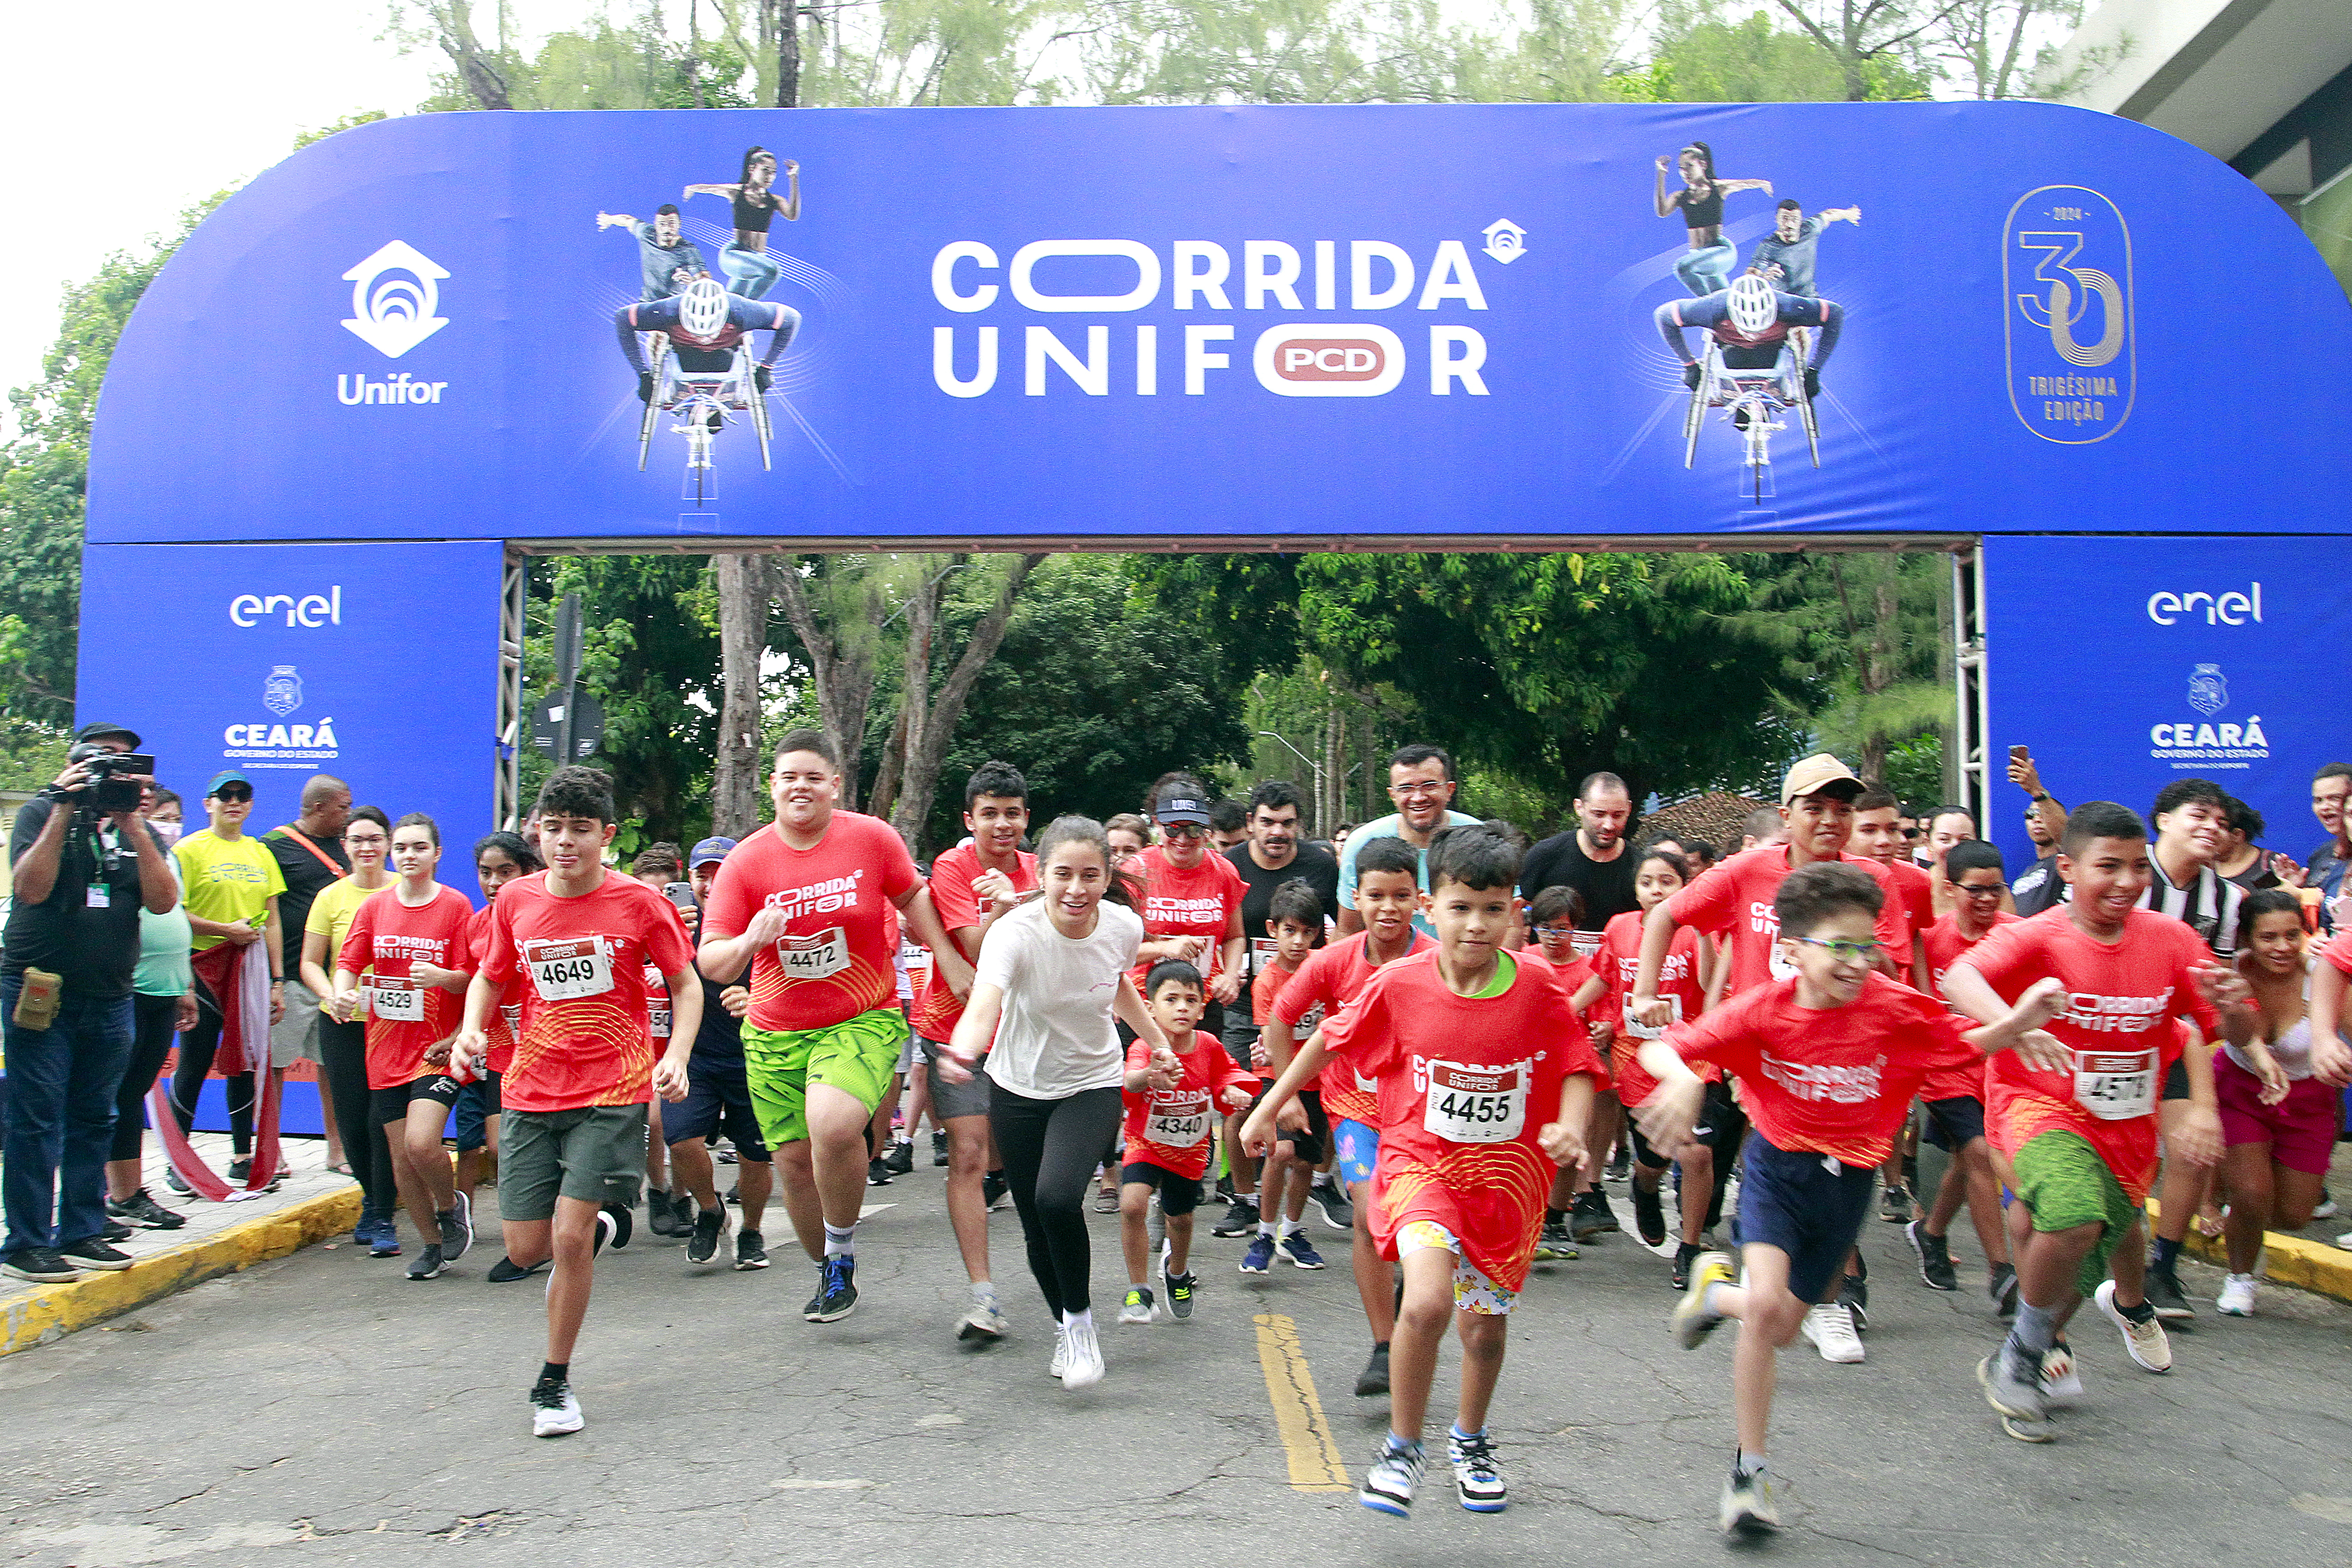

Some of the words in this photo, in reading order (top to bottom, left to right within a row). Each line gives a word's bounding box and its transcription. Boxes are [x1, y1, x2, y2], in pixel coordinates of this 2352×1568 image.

[931, 239, 1489, 313] CORRIDA
[933, 323, 1490, 397] UNIFOR
[1284, 348, 1377, 372] PCD
[338, 373, 448, 405] Unifor
[2029, 372, 2118, 397] TRIGÉSIMA
[2044, 398, 2105, 426] EDIÇÃO
[230, 585, 341, 627] enel
[2147, 581, 2263, 626] enel
[225, 716, 338, 748] CEARÁ
[2150, 715, 2269, 748] CEARÁ
[223, 749, 278, 758] GOVERNO
[2150, 749, 2206, 759] GOVERNO
[2225, 749, 2269, 759] ESTADO
[764, 875, 858, 908] CORRIDA
[1146, 897, 1223, 911] CORRIDA
[1145, 909, 1223, 923] UNIFOR
[540, 951, 577, 960] UNIFOR
[790, 946, 835, 967] 4472
[543, 960, 594, 985] 4649
[379, 991, 412, 1009] 4529
[1448, 1079, 1499, 1091] UNIFOR
[1449, 1072, 1499, 1084] CORRIDA
[1440, 1093, 1511, 1123] 4455
[1156, 1115, 1202, 1135] 4340
